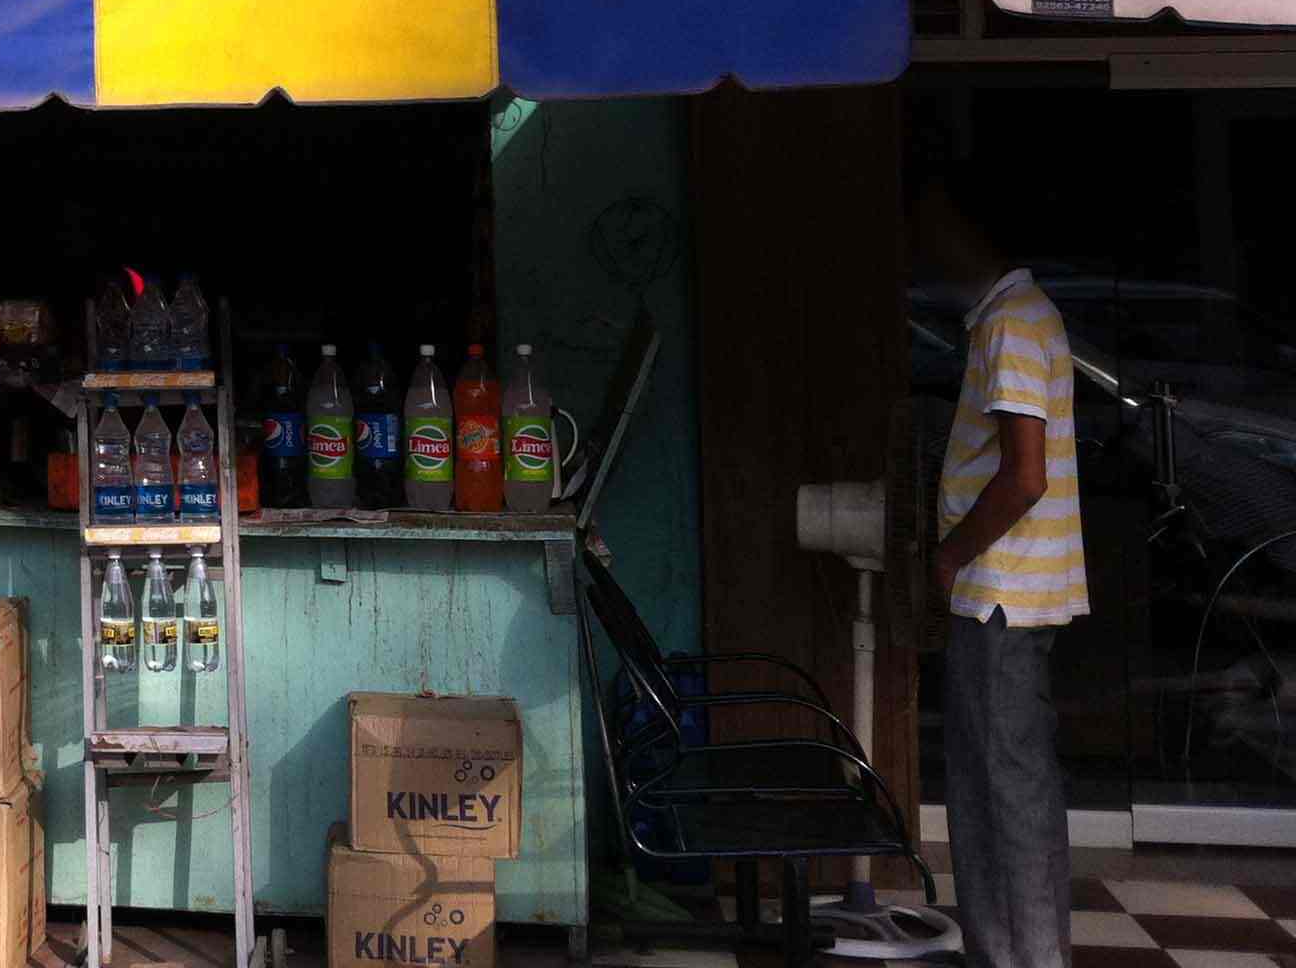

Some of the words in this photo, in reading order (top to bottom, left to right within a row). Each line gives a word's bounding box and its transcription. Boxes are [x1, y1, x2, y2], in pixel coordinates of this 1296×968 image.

[408, 439, 450, 454] Limca
[386, 791, 502, 823] KINLEY
[355, 931, 472, 965] KINLEY
